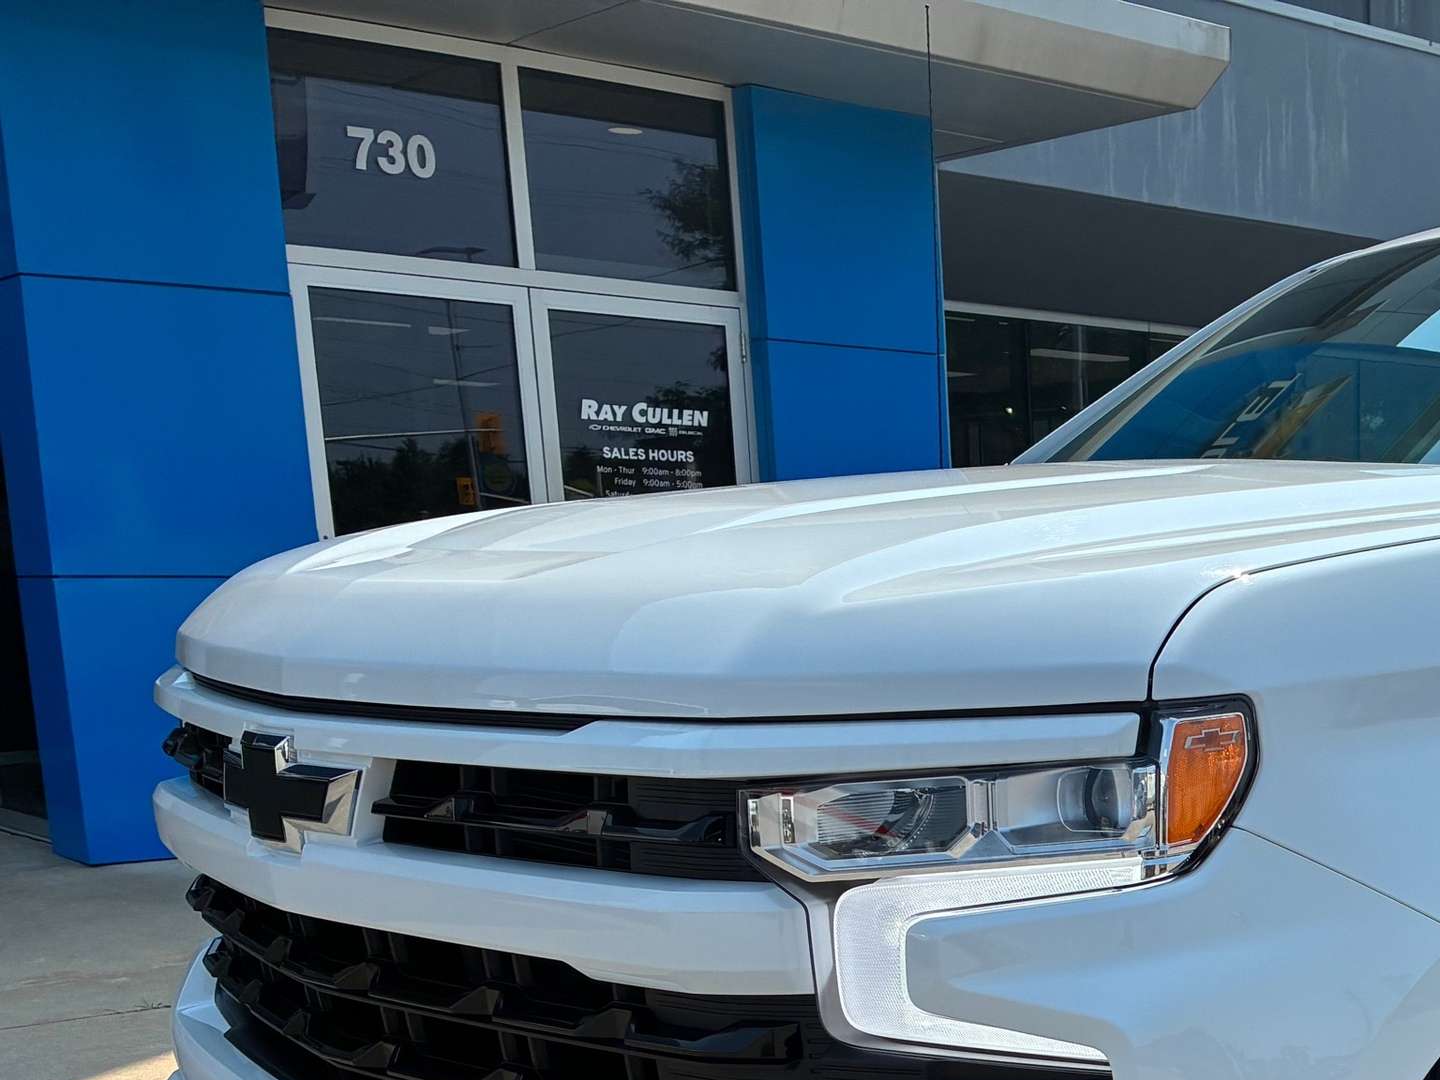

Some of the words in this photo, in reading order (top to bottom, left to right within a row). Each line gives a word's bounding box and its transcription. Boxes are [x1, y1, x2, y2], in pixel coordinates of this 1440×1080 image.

[346, 126, 436, 178] 730
[581, 399, 627, 422] RAY
[631, 402, 709, 428] CULLEN
[645, 427, 667, 435] GMC
[602, 446, 646, 460] SALES
[648, 448, 695, 462] HOURS
[597, 465, 612, 473] Mon
[642, 467, 670, 476] 9:00am
[675, 469, 702, 479] 8:00pm
[614, 477, 636, 487] Friday
[643, 479, 670, 488] 9:00am
